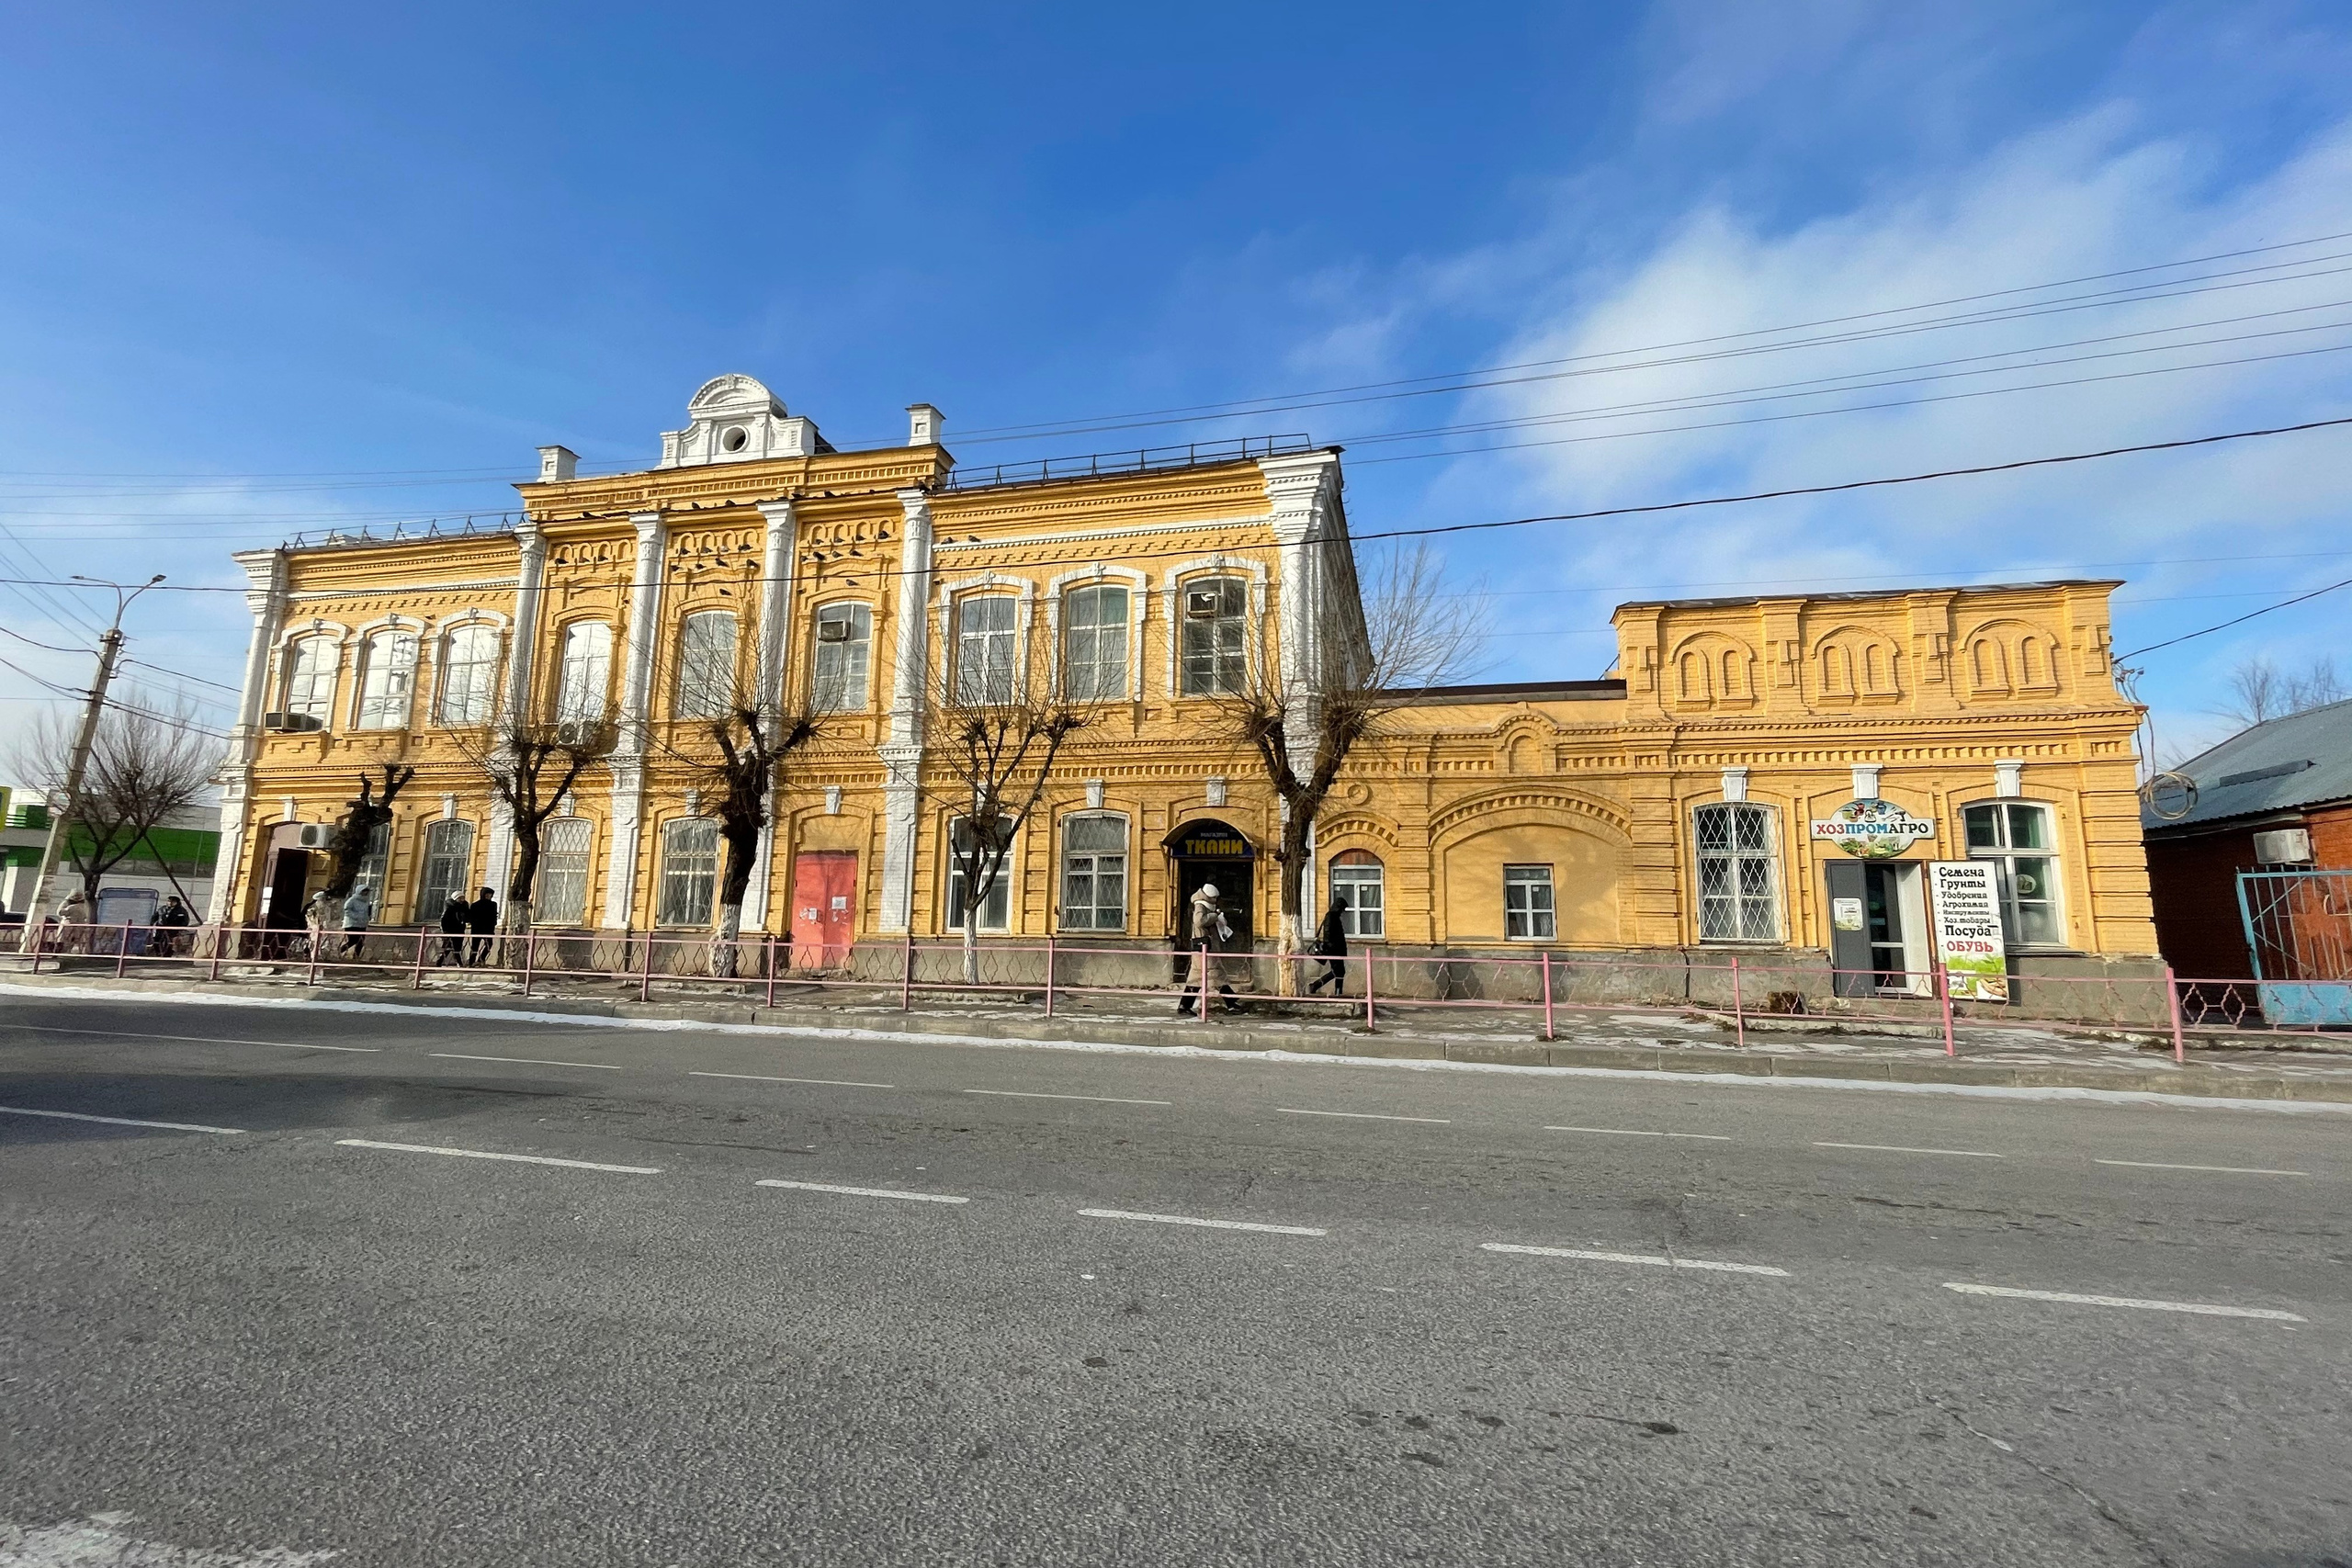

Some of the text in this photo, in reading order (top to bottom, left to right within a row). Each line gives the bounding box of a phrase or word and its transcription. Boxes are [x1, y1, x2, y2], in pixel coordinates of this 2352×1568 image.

[1816, 823, 1928, 835] ХОЗПРОМАГРО
[1185, 840, 1243, 854] ТКАНИ
[1939, 878, 1986, 890] Грунты
[1941, 891, 1988, 900] Удобрения
[1942, 901, 1989, 909] Агрохимия
[1944, 925, 1992, 939] Посуда
[1946, 940, 1994, 953] ОБУВЬ
